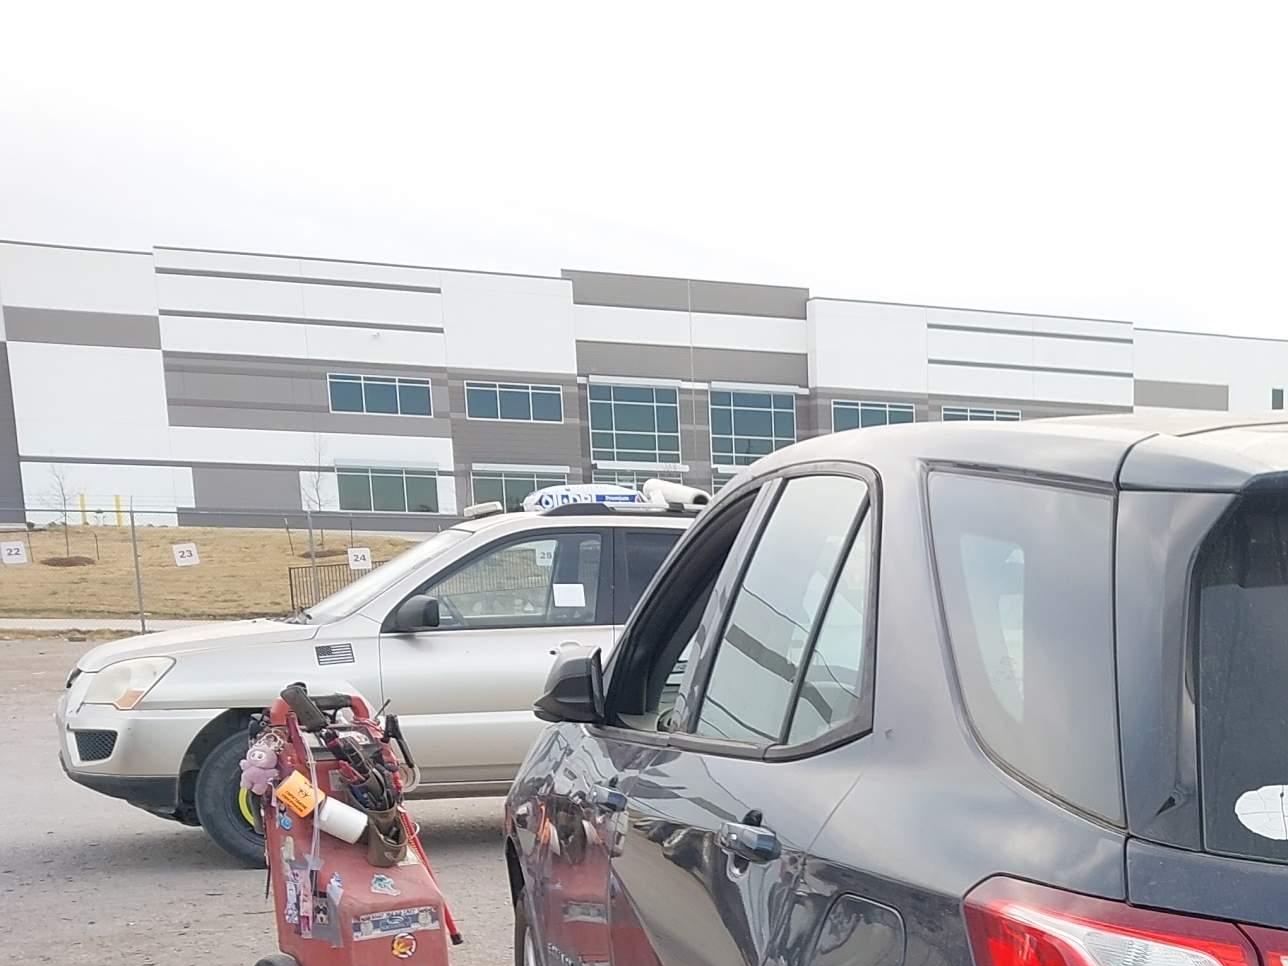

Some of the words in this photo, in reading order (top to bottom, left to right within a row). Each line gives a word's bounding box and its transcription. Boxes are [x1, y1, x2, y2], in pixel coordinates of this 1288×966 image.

[6, 547, 21, 556] 22
[178, 549, 194, 559] 23
[352, 553, 367, 562] 24
